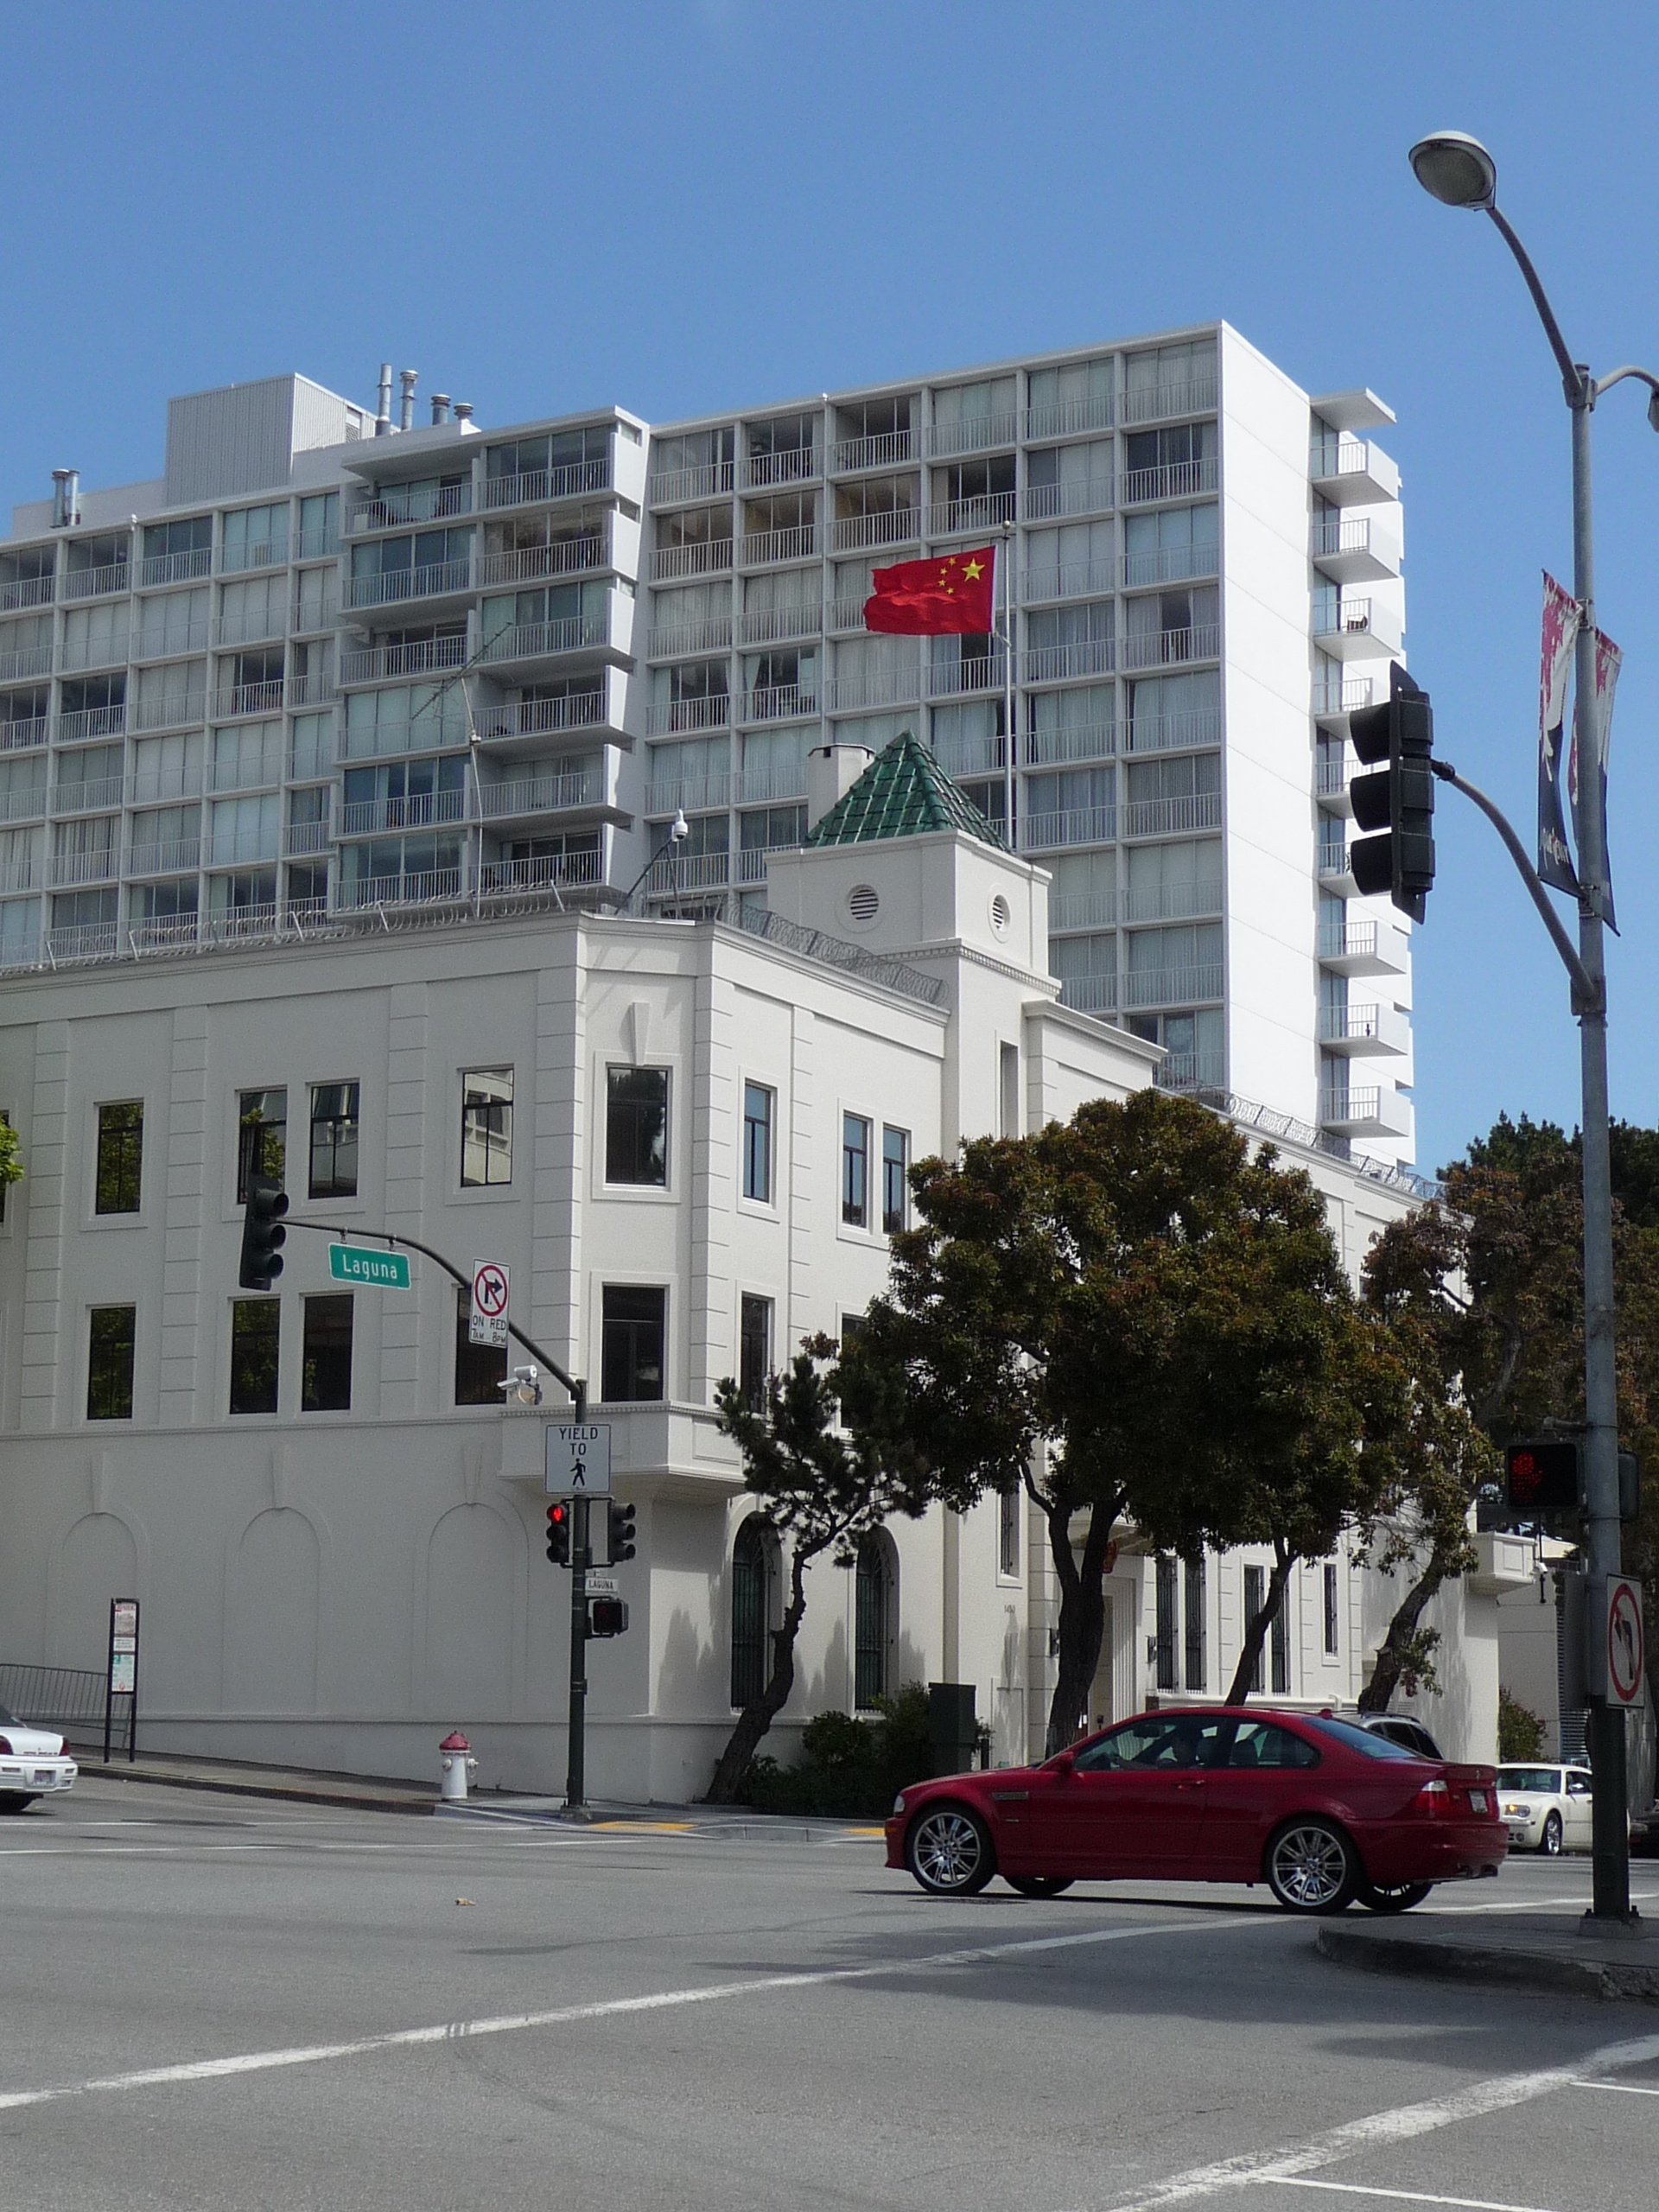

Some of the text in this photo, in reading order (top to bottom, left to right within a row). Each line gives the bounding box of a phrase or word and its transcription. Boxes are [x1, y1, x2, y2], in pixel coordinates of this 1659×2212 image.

[343, 1254, 397, 1281] Laguna
[473, 1315, 506, 1331] ON RED
[471, 1328, 484, 1340] 7AM
[493, 1332, 505, 1343] 8PM
[559, 1427, 598, 1440] YIELD
[569, 1442, 587, 1456] TO
[588, 1579, 613, 1589] LAGUNA
